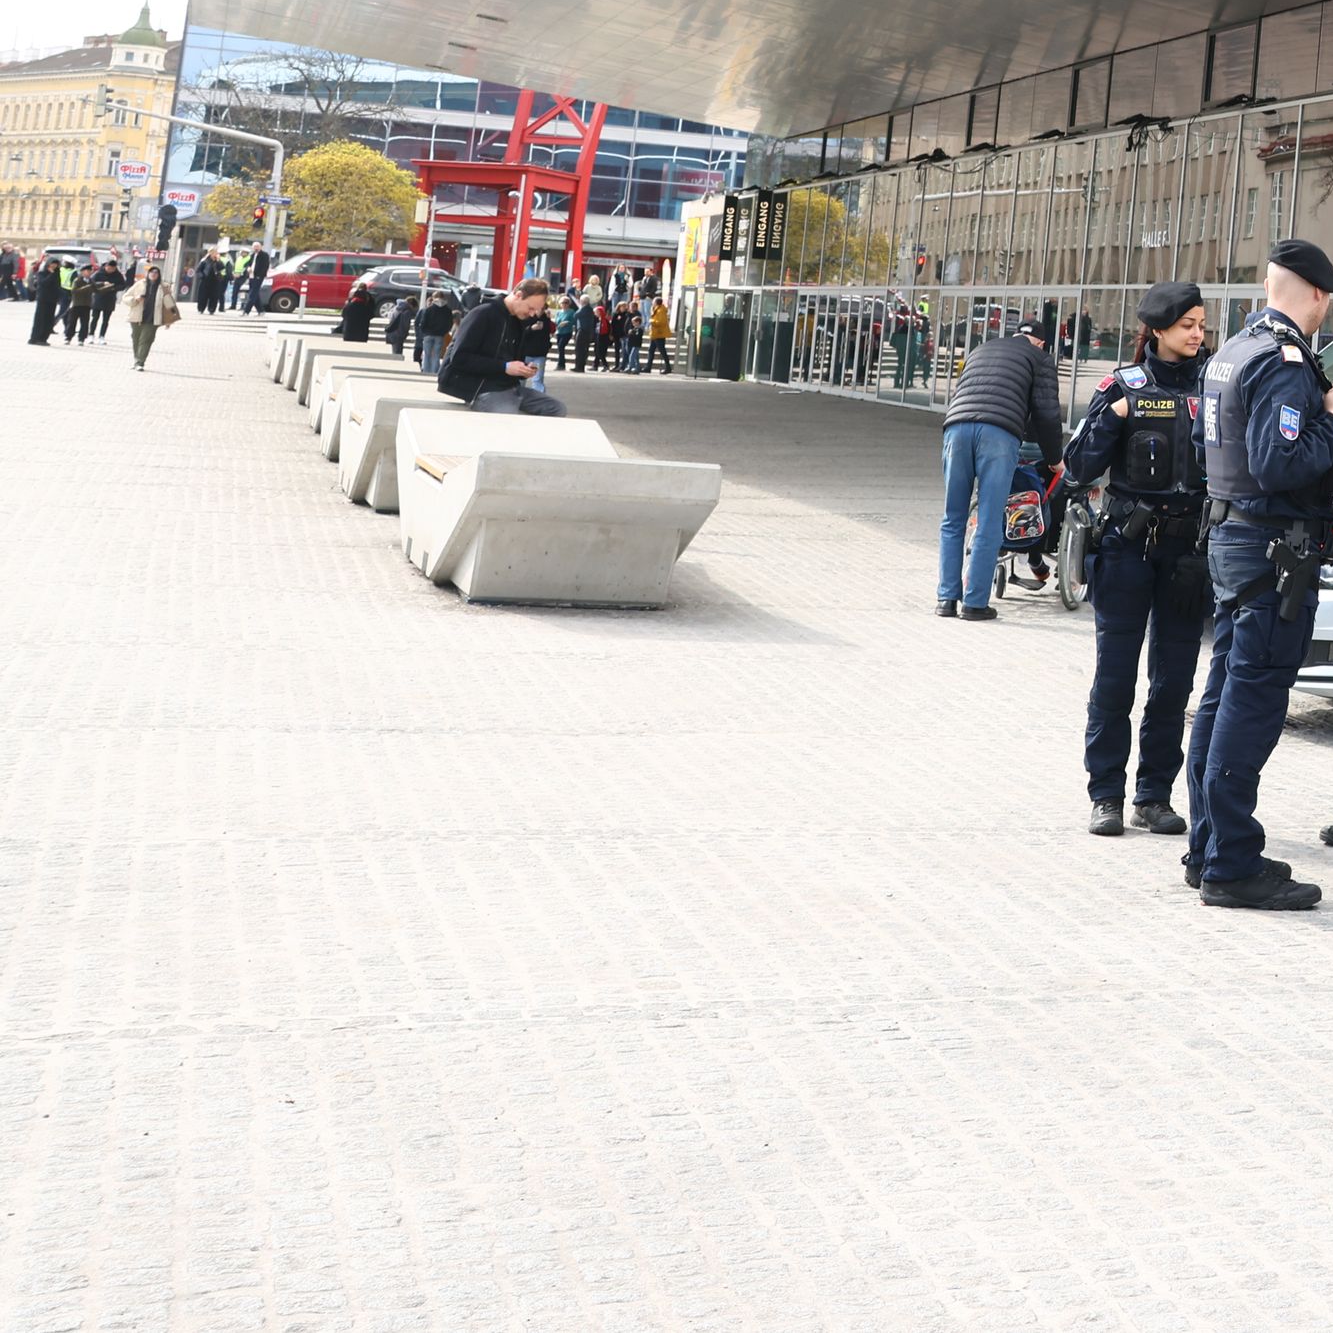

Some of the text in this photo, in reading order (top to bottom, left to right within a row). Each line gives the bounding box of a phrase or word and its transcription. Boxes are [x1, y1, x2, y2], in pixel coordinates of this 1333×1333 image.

[722, 207, 736, 251] EINGANG
[757, 200, 770, 248] EINGANG
[1141, 231, 1162, 248] HALLE
[1137, 399, 1176, 409] POLIZEI
[1282, 411, 1299, 429] BE
